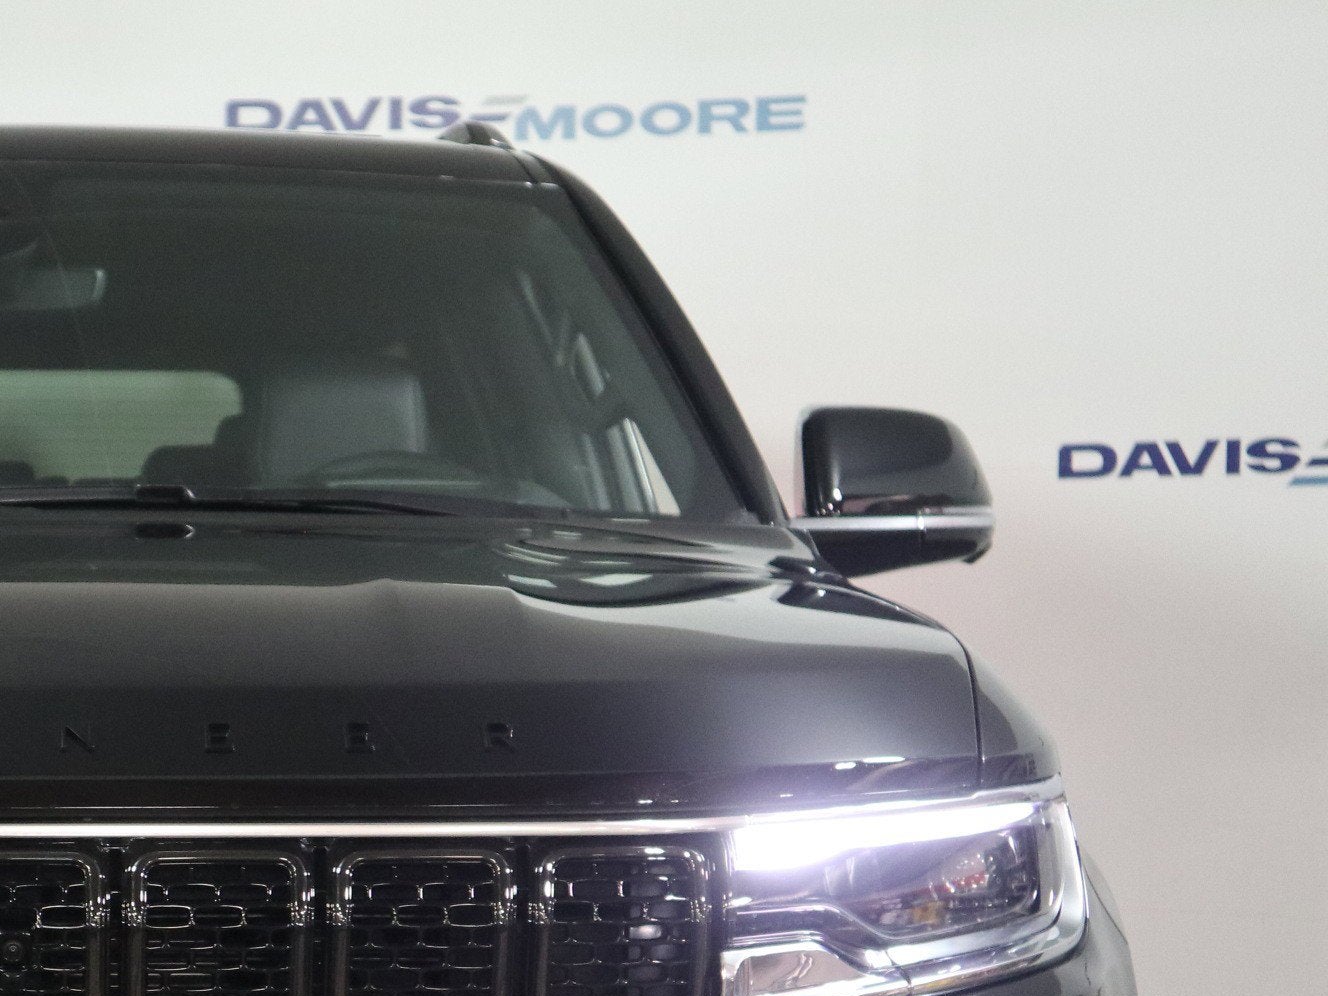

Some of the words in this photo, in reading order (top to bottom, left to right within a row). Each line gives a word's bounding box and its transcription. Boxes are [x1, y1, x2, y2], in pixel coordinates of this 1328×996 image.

[225, 95, 460, 131] DAVIS
[512, 95, 806, 141] MOORE
[1058, 437, 1302, 480] DAVIS
